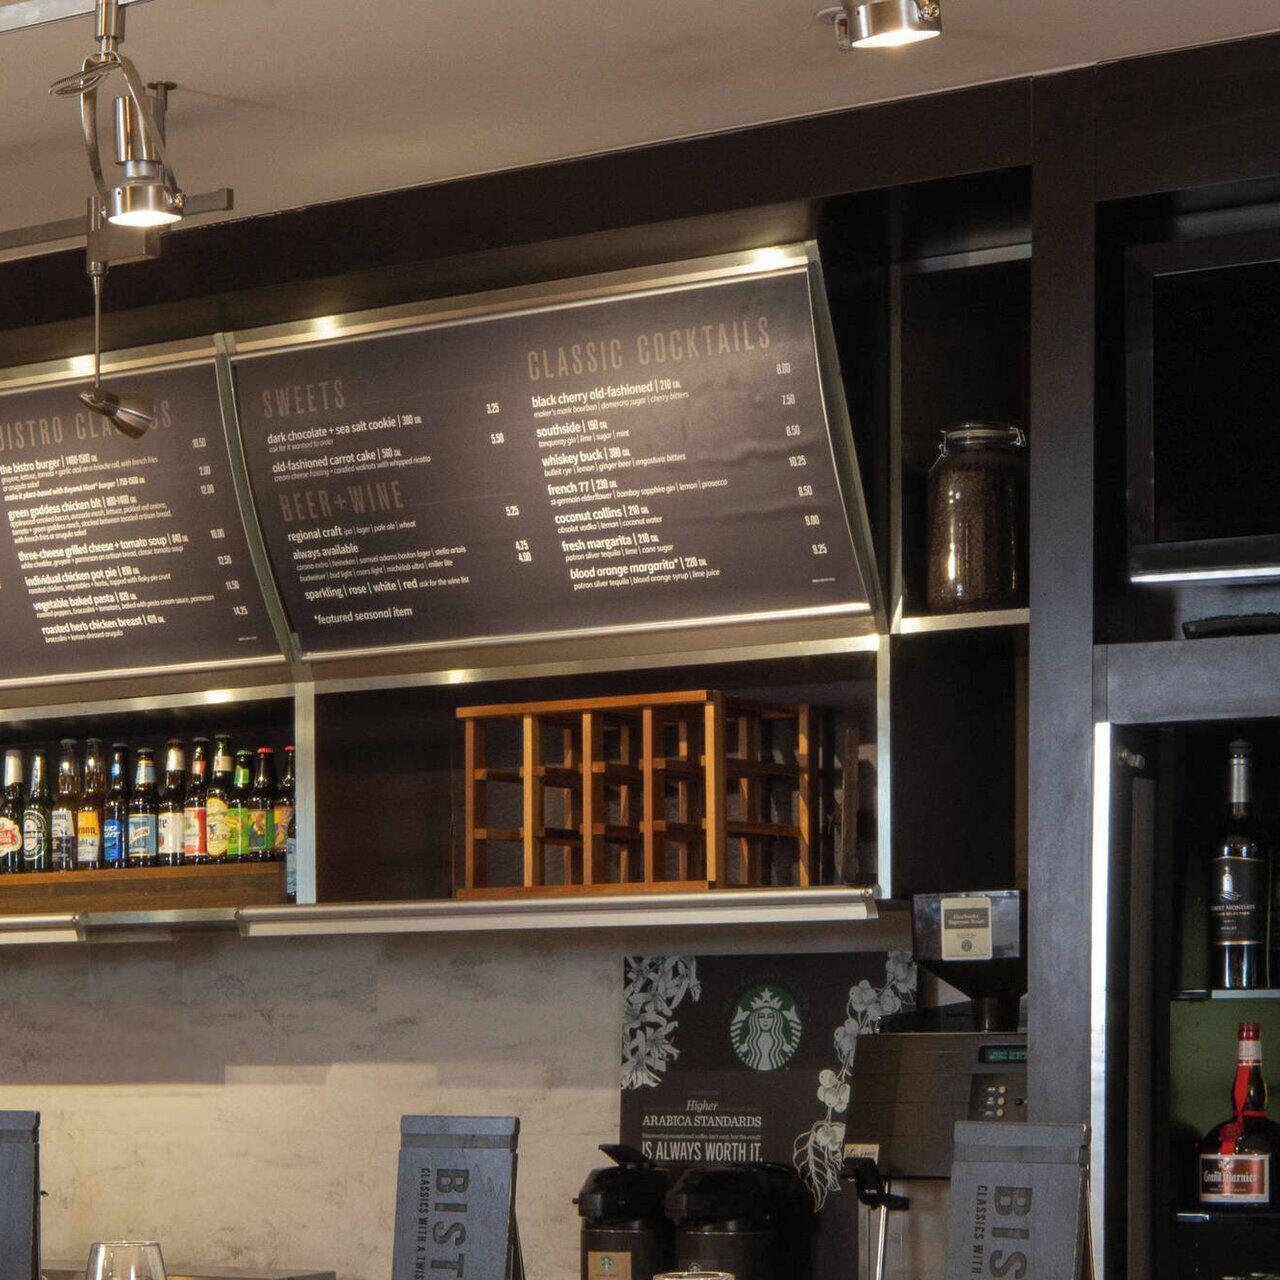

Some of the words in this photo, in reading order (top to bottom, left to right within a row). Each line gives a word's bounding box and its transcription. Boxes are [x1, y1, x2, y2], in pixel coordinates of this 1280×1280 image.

[528, 339, 621, 381] CLASSIC
[637, 316, 770, 365] COCKTAILS
[262, 380, 345, 419] SWEETS
[531, 395, 557, 408] black
[558, 390, 588, 407] cherry
[589, 382, 653, 400] old-fashioned
[267, 431, 287, 445] dark
[287, 427, 328, 443] chocolate
[335, 425, 351, 437] sea
[351, 420, 367, 433] salt
[368, 417, 397, 431] cookie
[536, 421, 582, 438] southside
[0, 463, 12, 476] the
[12, 460, 35, 473] bistro
[35, 457, 61, 473] burger
[272, 455, 328, 473] old-fashioned
[329, 453, 355, 466] carrot
[356, 450, 376, 463] cake
[542, 450, 579, 468] whiskey
[580, 448, 603, 463] buck
[548, 482, 577, 496] french
[578, 481, 590, 493] 77
[8, 506, 29, 521] green
[29, 502, 61, 519] goddess
[61, 499, 90, 512] chicken
[91, 497, 101, 509] blt
[280, 481, 404, 522] BEER+WINE
[554, 510, 592, 524] coconut
[593, 507, 622, 521] collins
[287, 528, 321, 544] regional
[322, 525, 343, 538] craft
[562, 539, 586, 551] fresh
[587, 535, 632, 551] margarita
[18, 546, 65, 562] three-cheese
[65, 544, 88, 559] grilled
[88, 541, 113, 554] cheese
[120, 538, 147, 551] tomato
[148, 535, 167, 549] soup
[292, 547, 321, 561] always
[321, 543, 359, 558] available
[24, 571, 62, 587] individual
[62, 568, 90, 583] chicken
[91, 567, 104, 580] pot
[104, 565, 117, 579] pie
[570, 565, 595, 580] blood
[597, 563, 628, 579] orange
[304, 586, 343, 602] sparkling
[348, 584, 367, 596] rose
[372, 580, 396, 593] white
[403, 577, 418, 590] red
[32, 595, 69, 612] vegetable
[69, 593, 94, 607] baked
[94, 592, 115, 606] pasta
[41, 621, 70, 634] roasted
[70, 619, 89, 632] herb
[90, 617, 118, 630] chicken
[119, 614, 144, 628] breast
[354, 608, 392, 622] seasonal
[393, 606, 413, 619] item
[686, 1100, 719, 1112] Higher
[642, 1115, 694, 1127] ARABICA
[694, 1115, 762, 1128] STANDARDS
[655, 1141, 701, 1161] ALWAYS
[705, 1142, 746, 1161] WORTH
[750, 1142, 763, 1162] IT.
[974, 1184, 988, 1240] CLASSICS
[972, 1245, 985, 1274] WITH
